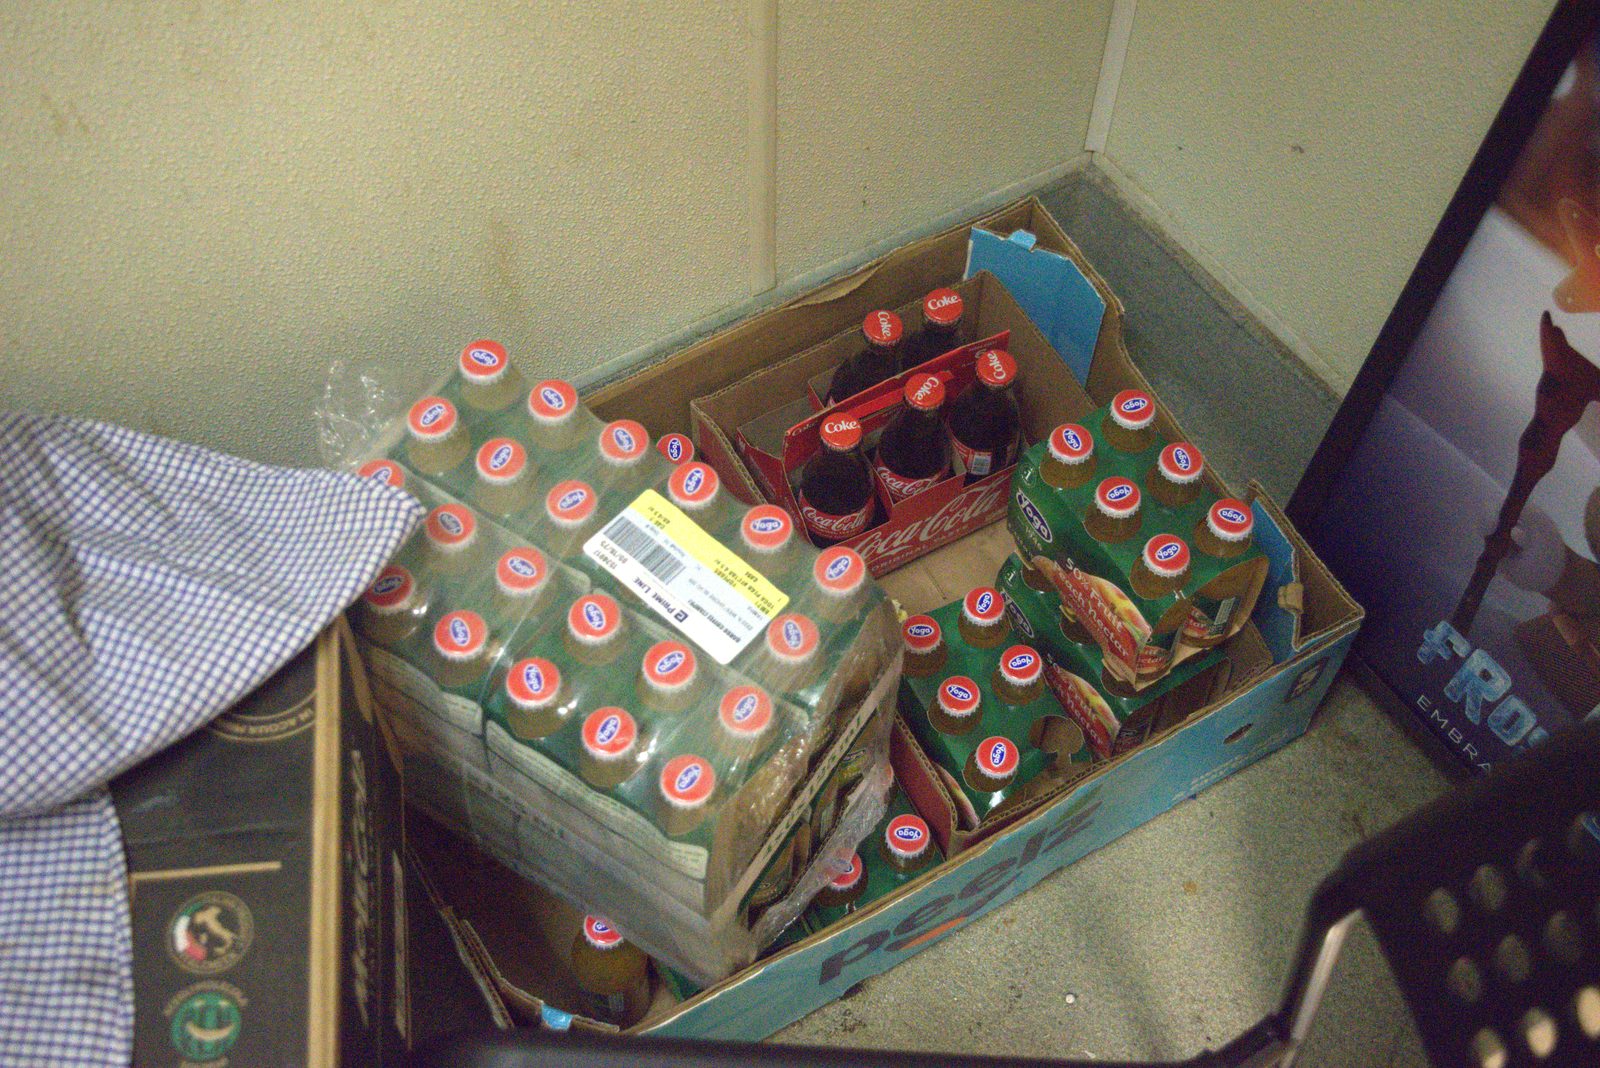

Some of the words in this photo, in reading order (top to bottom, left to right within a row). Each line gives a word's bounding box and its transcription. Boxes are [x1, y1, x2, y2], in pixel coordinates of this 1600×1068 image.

[928, 294, 958, 310] Coke
[877, 311, 891, 337] Coke
[986, 352, 1006, 380] Coke
[913, 377, 939, 401] Coke
[1122, 398, 1146, 412] Yoga
[825, 421, 857, 434] Coke
[669, 439, 681, 459] Yoga
[1064, 429, 1080, 449] Yoga
[491, 448, 510, 468] Yoga
[1174, 449, 1190, 470] Yoga
[685, 470, 702, 493] Yoga
[561, 491, 585, 508] Yoga
[1108, 485, 1130, 500] Yoga
[1017, 487, 1051, 541] Yoga
[1219, 508, 1245, 523] Yoga
[753, 518, 781, 532] Yoga
[1157, 543, 1179, 560] Yoga
[510, 558, 534, 575] Yoga
[828, 558, 849, 577] Yoga
[631, 576, 651, 594] LINE
[650, 591, 676, 614] PRIME
[977, 593, 992, 612] Yoga
[1090, 588, 1124, 633] Fruit
[584, 603, 604, 628] Yoga
[909, 624, 933, 637] Yoga
[658, 653, 684, 673] Yoga
[1010, 654, 1033, 669] Yoga
[525, 665, 543, 691] Yoga
[948, 685, 971, 701] Yoga
[735, 696, 756, 719] Yoga
[599, 717, 619, 742] Yoga
[991, 742, 1006, 766] Yoga
[676, 765, 700, 790] Yoga
[896, 827, 921, 840] Yoga
